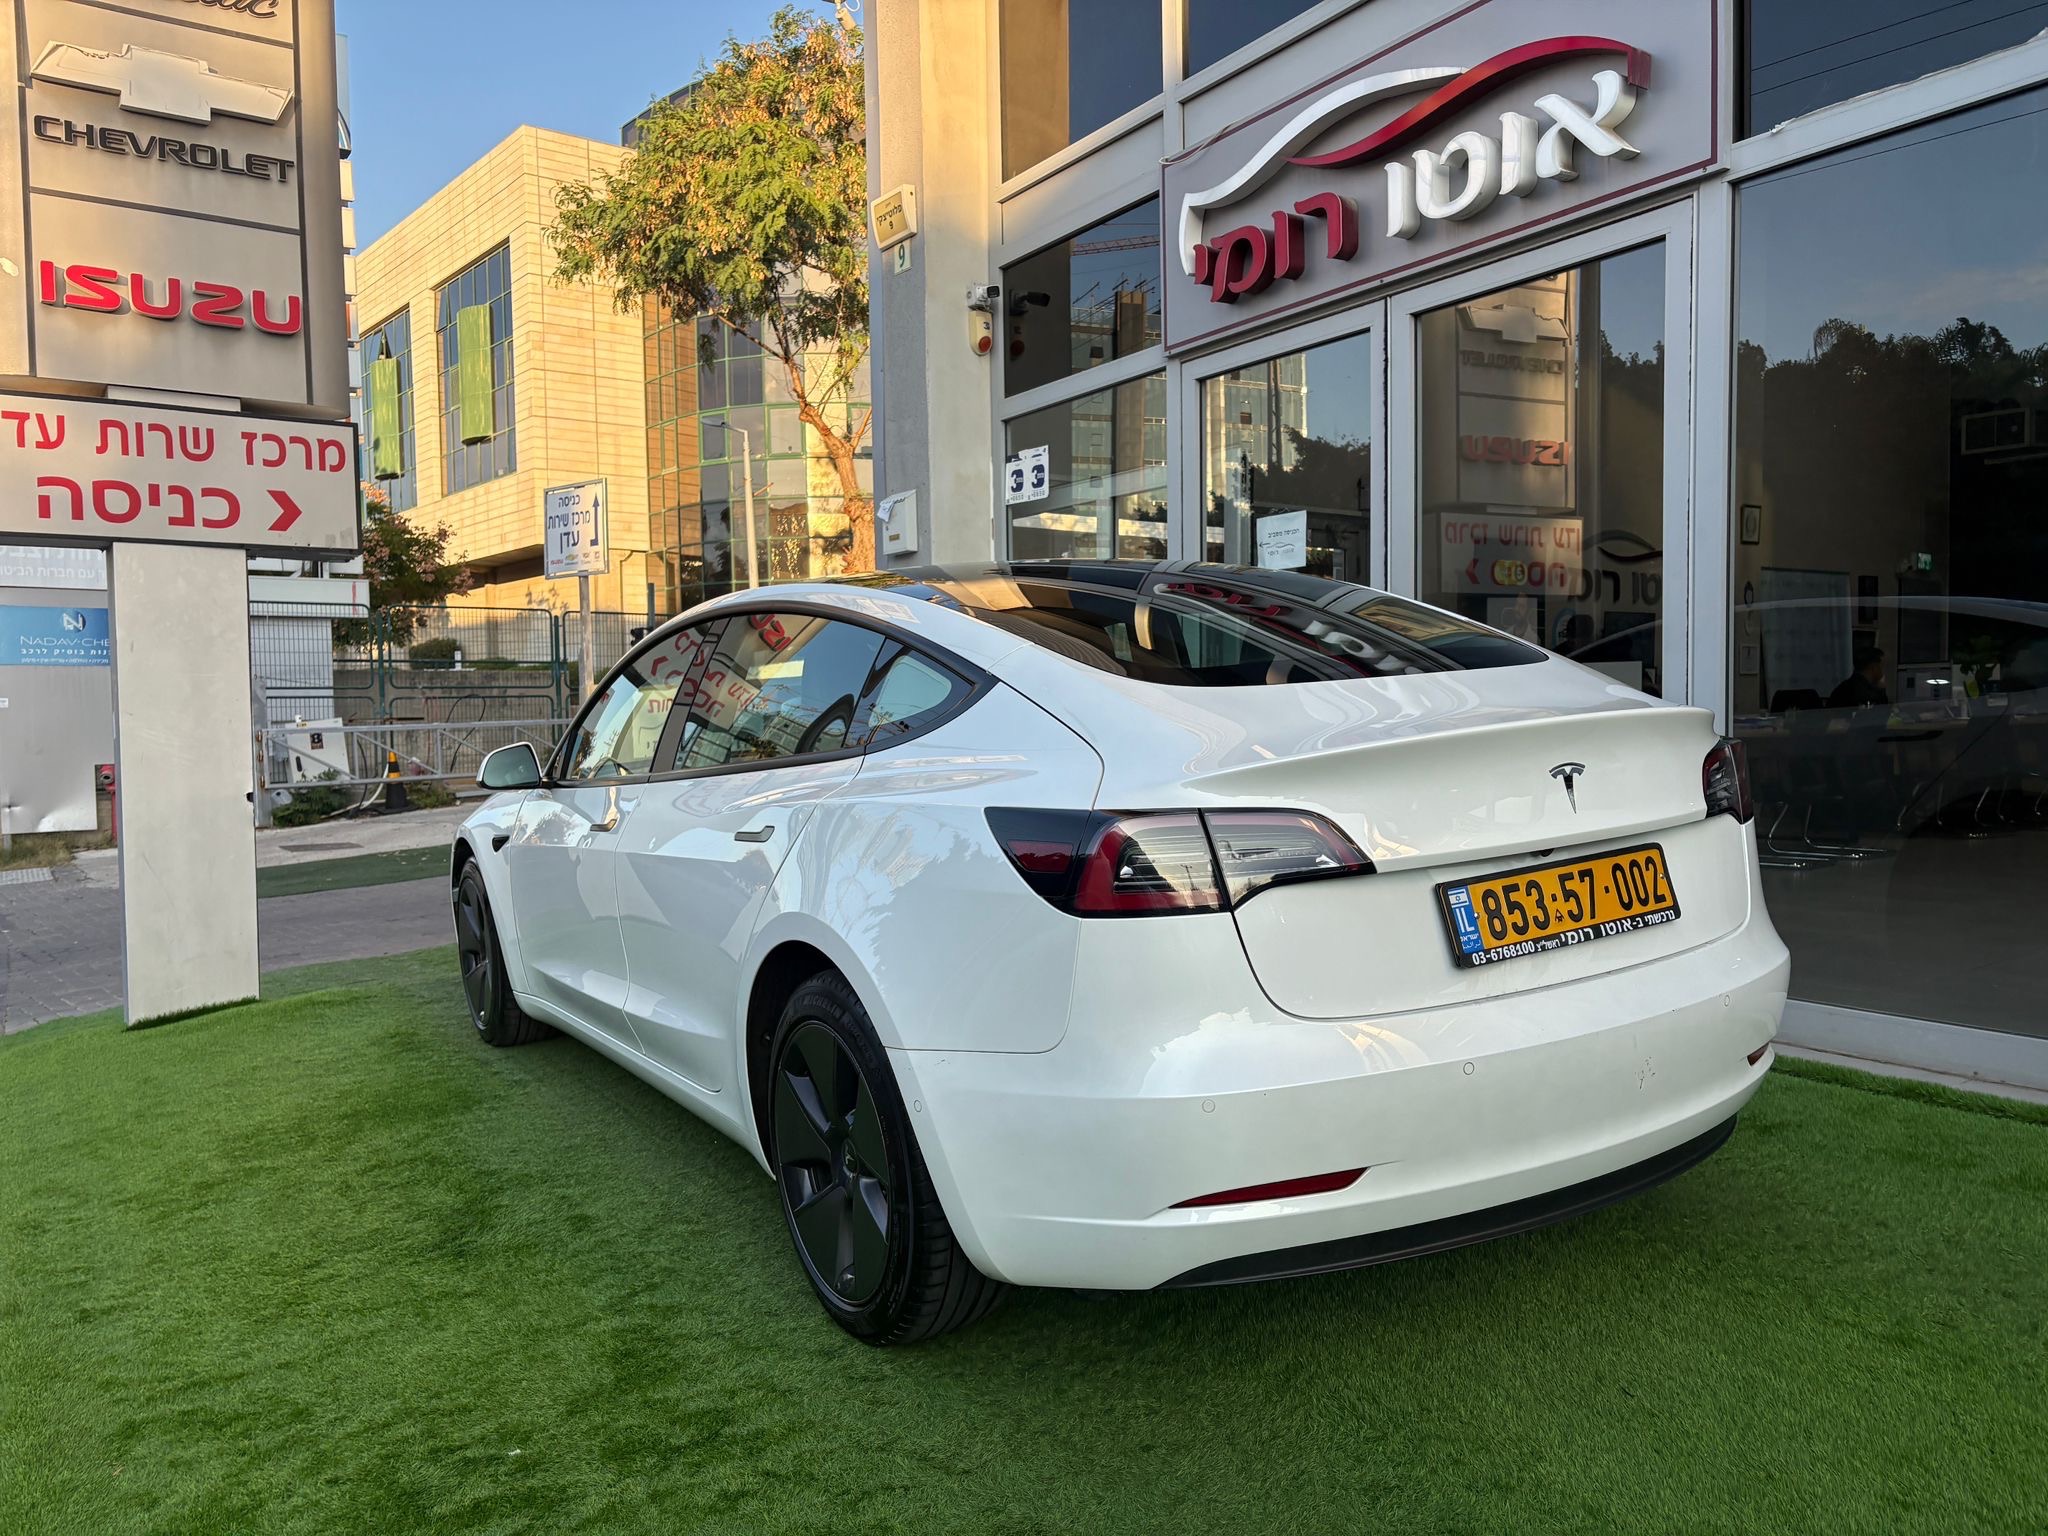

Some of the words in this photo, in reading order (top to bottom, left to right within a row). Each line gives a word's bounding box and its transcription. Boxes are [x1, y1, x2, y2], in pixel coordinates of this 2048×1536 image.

[33, 114, 295, 183] CHEVROLET
[1384, 69, 1641, 239] אוטו
[898, 244, 905, 268] 9
[1195, 192, 1359, 303] רומי
[40, 260, 302, 335] ISUZU
[96, 419, 215, 462] שרות
[240, 431, 346, 473] מרכז
[37, 476, 241, 530] כניסה
[558, 494, 580, 507] כניסה
[571, 510, 591, 525] מרכז
[559, 530, 580, 554] עדן
[1456, 907, 1474, 932] IL
[1645, 910, 1675, 926] נרכשתי
[1560, 927, 1595, 945] רומי
[1472, 940, 1535, 965] 03-6768100
